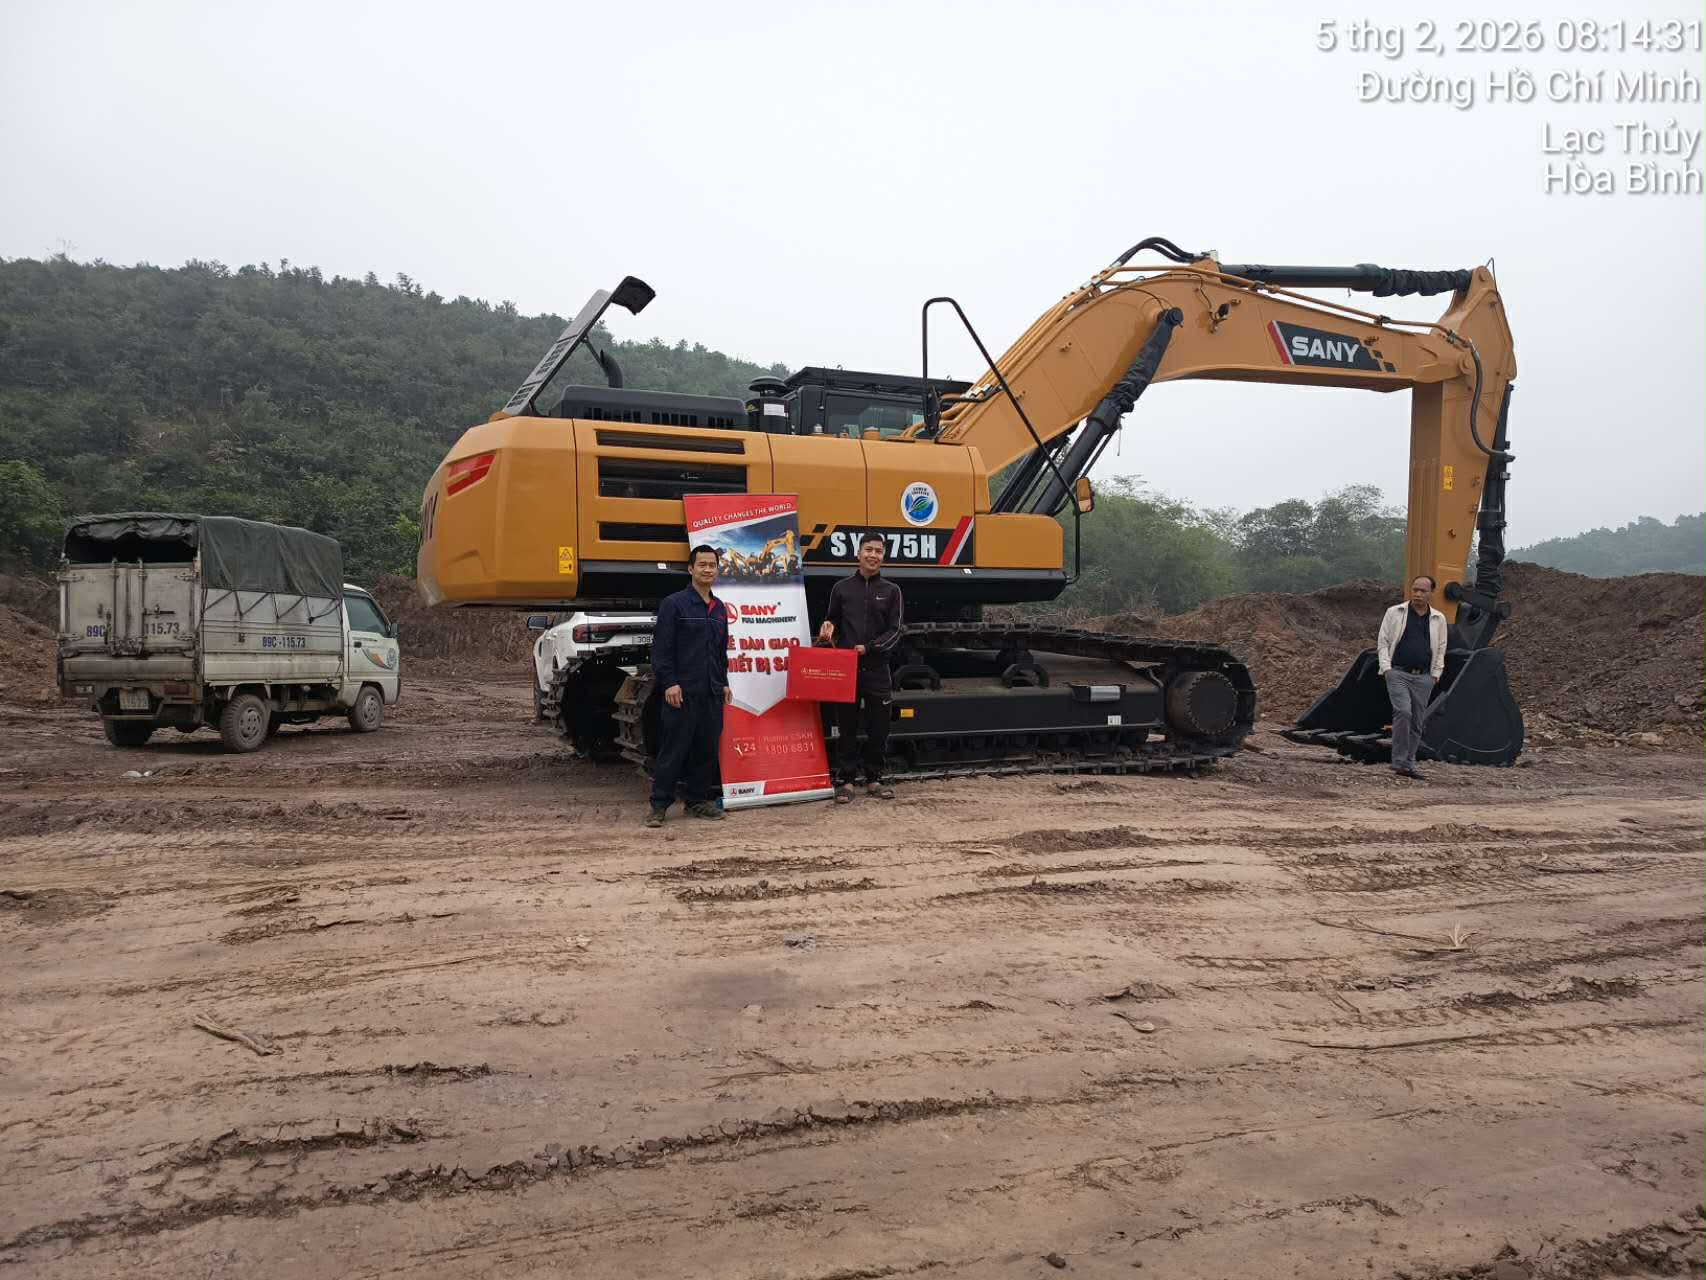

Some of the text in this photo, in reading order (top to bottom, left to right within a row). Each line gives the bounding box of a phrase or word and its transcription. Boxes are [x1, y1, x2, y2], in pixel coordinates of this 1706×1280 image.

[1291, 335, 1360, 363] SANY
[693, 502, 792, 528] QUALITY CHANGES THE WORLD
[830, 531, 937, 559] SY75H
[740, 604, 778, 616] SANY
[756, 615, 797, 624] MACHINERY
[739, 635, 765, 650] BÀN
[767, 637, 800, 650] GIAO
[755, 656, 771, 675] BỊ
